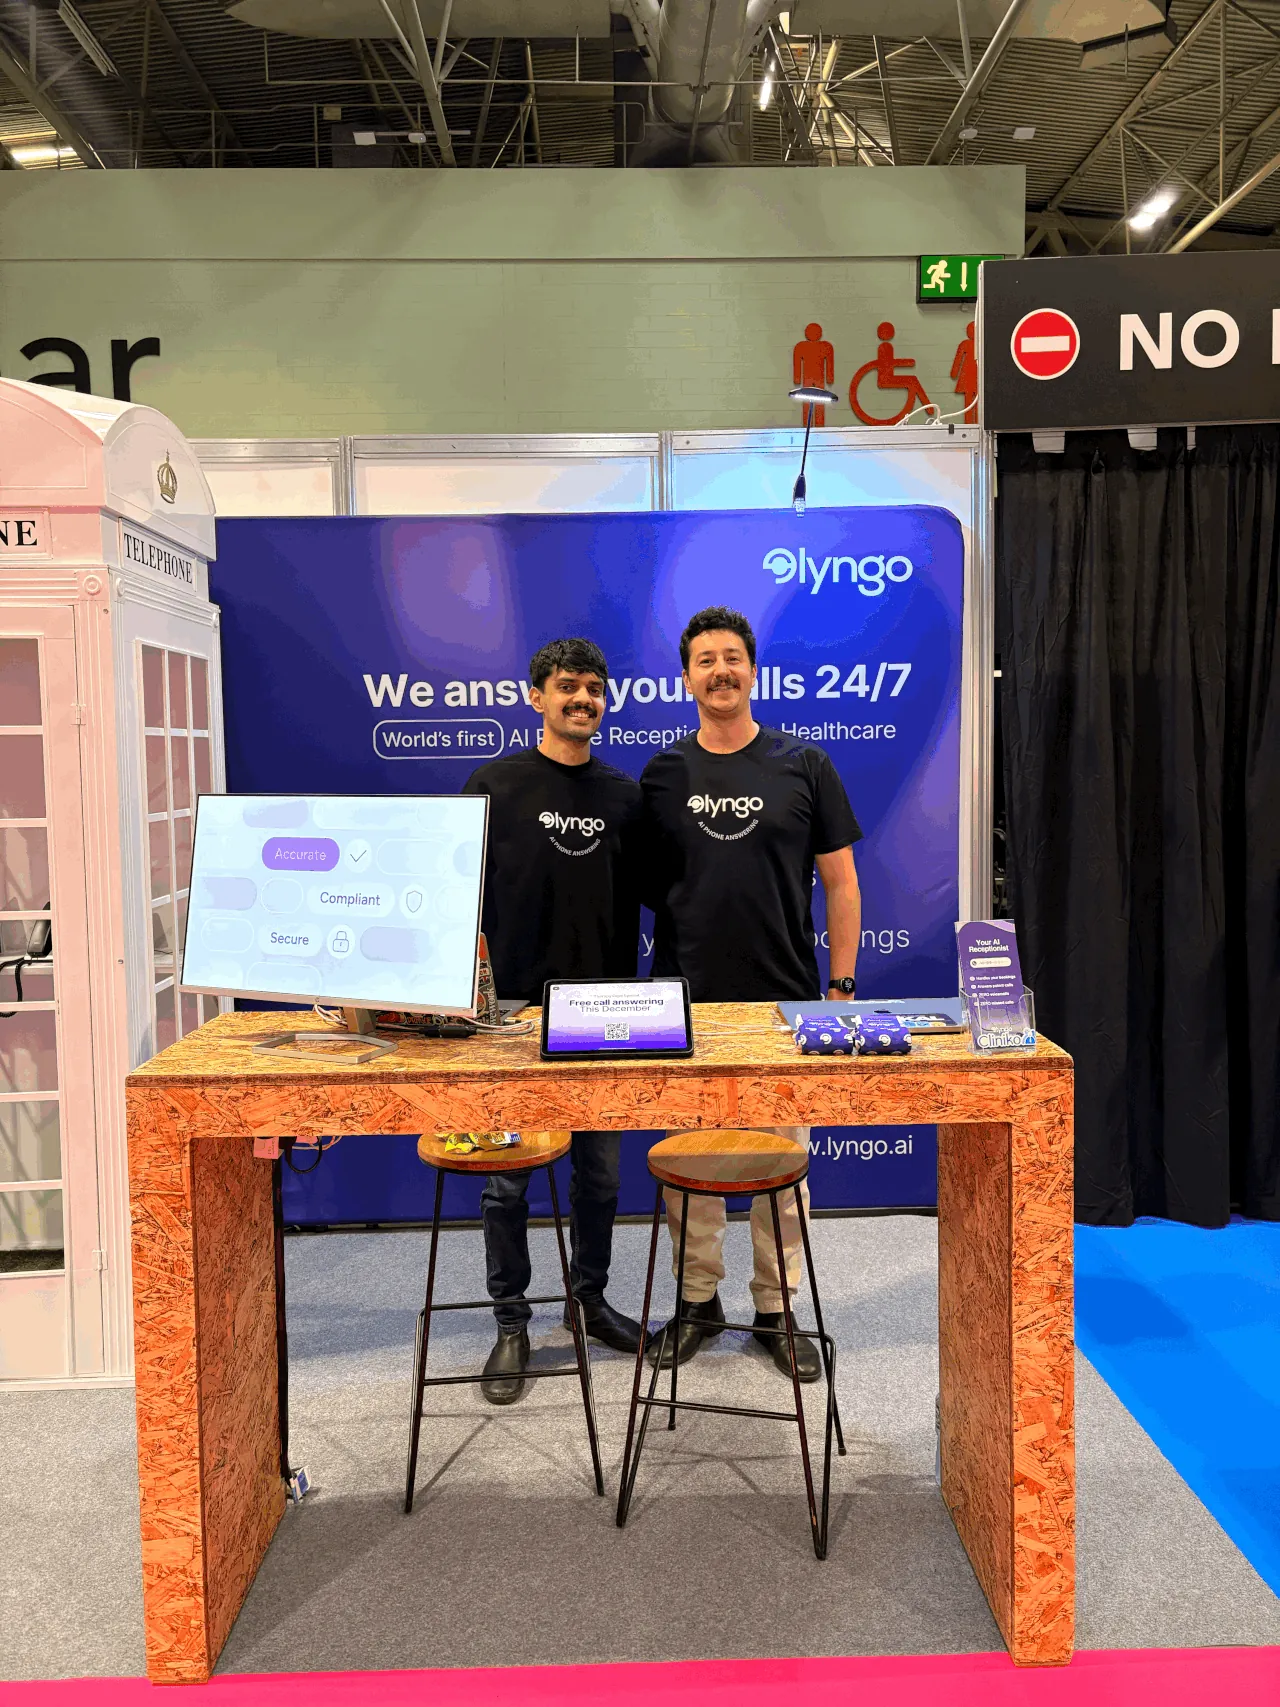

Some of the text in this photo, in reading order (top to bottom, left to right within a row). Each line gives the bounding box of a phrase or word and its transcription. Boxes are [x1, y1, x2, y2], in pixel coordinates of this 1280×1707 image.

[1120, 309, 1240, 371] NO
[0, 336, 161, 403] ar
[123, 532, 194, 584] TELEPHONE
[798, 547, 914, 597] lyngo
[363, 673, 435, 708] We
[443, 679, 534, 707] ans
[749, 666, 806, 700] lls
[815, 662, 912, 703] 24/7
[381, 730, 452, 748] World's
[456, 730, 496, 747] first
[508, 728, 529, 747] AI
[608, 724, 697, 750] Recepti
[704, 794, 764, 819] lyngo
[554, 811, 606, 837] lyngo
[697, 818, 759, 841] AI PHONE ANSWERING
[274, 847, 327, 861] Accurate
[553, 841, 573, 856] PHONE
[571, 837, 601, 857] ANSWERING
[319, 891, 381, 907] Compliant
[269, 931, 310, 946] Secure
[968, 944, 1010, 954] Receptionist
[975, 938, 1001, 947] Your AI
[580, 1004, 652, 1013] This December
[593, 998, 611, 1006] call
[612, 997, 664, 1006] answering
[978, 1032, 1021, 1048] Cliniko
